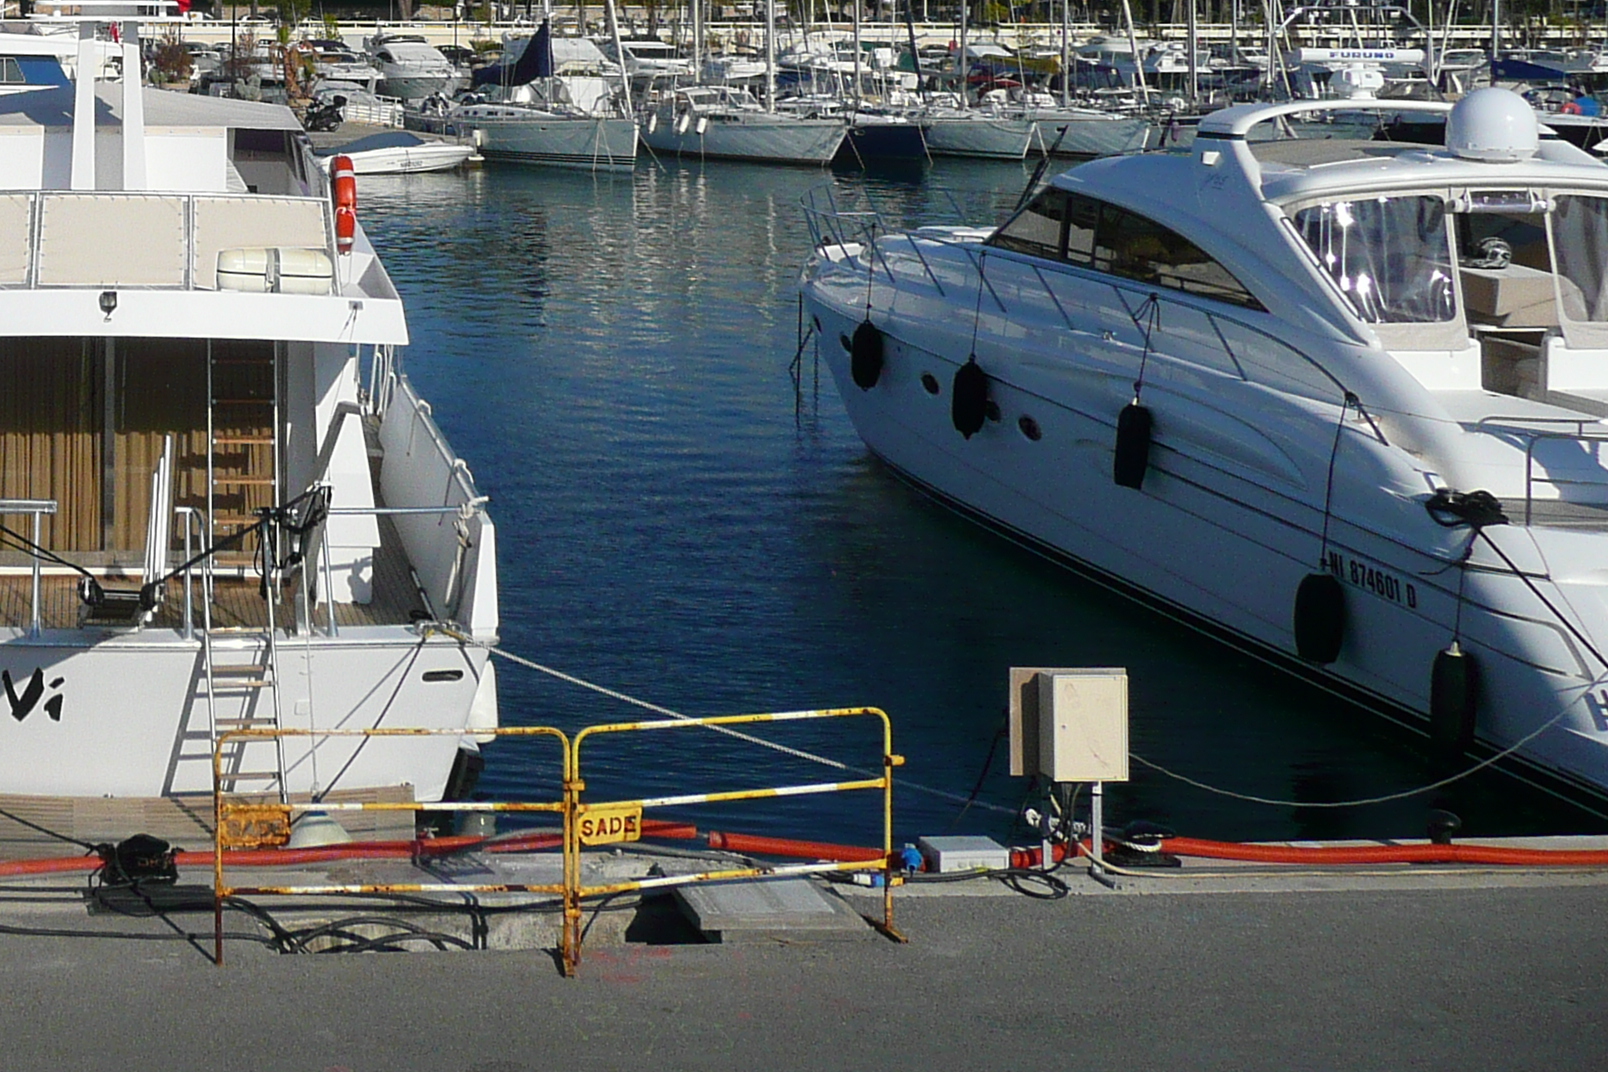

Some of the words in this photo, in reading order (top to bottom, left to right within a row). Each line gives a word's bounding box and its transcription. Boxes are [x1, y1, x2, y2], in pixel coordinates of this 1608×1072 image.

[1329, 51, 1395, 59] FURUNO
[1329, 551, 1344, 578] NI
[1349, 560, 1401, 603] 874601
[581, 815, 637, 838] SADE
